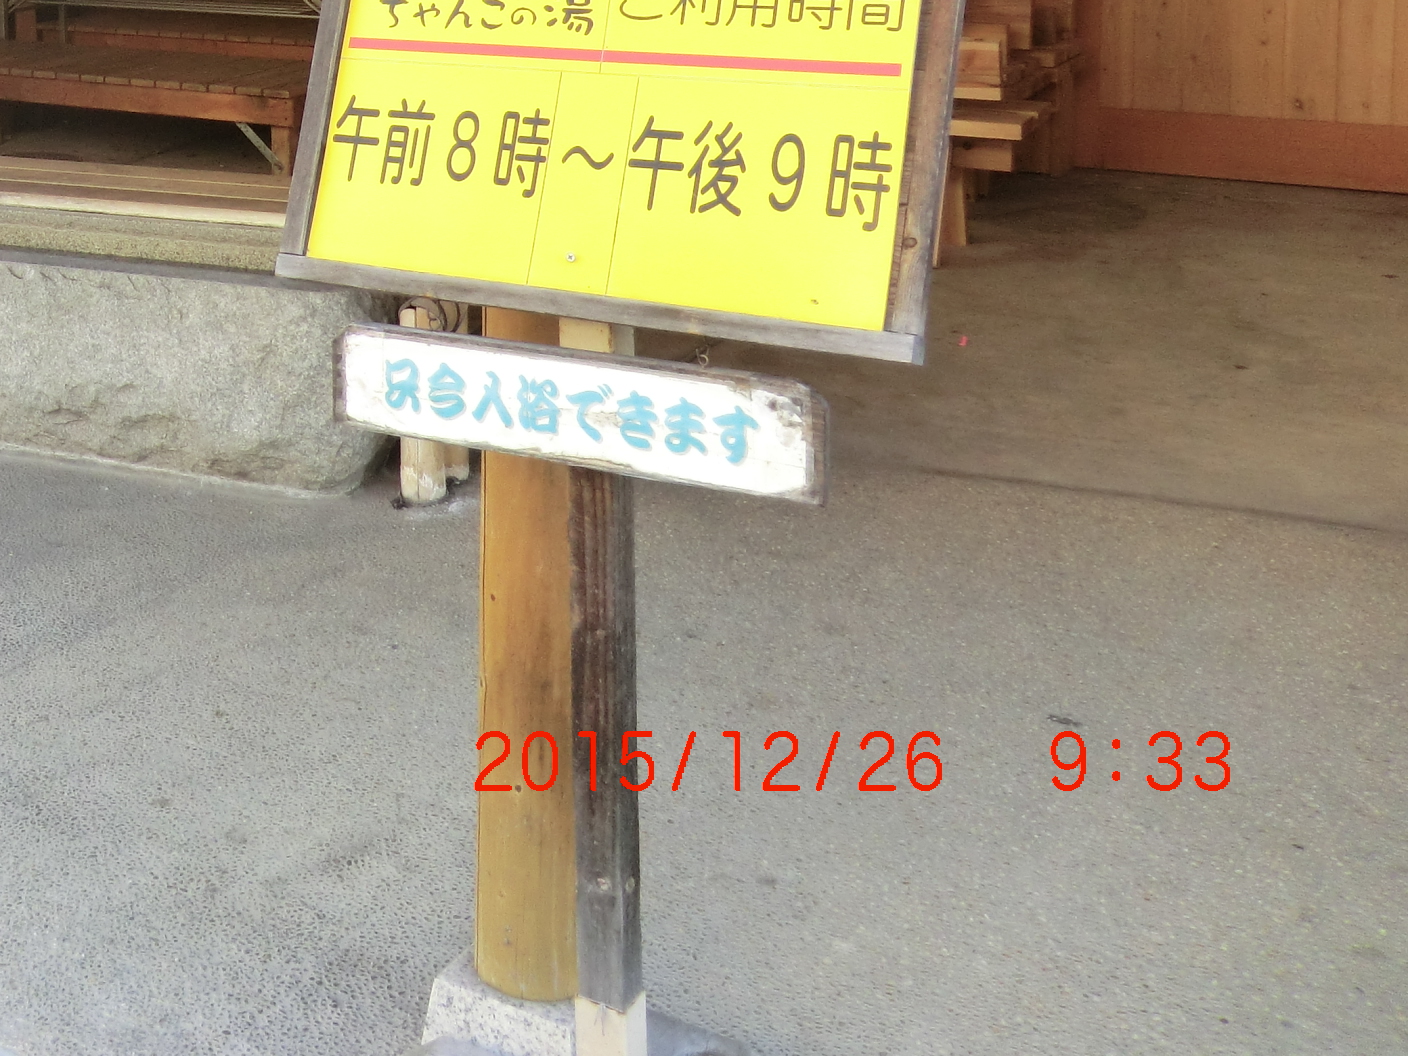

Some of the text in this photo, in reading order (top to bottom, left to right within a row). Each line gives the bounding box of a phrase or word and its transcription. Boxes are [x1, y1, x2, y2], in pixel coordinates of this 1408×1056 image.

[385, 357, 760, 465] 只今入浴できます
